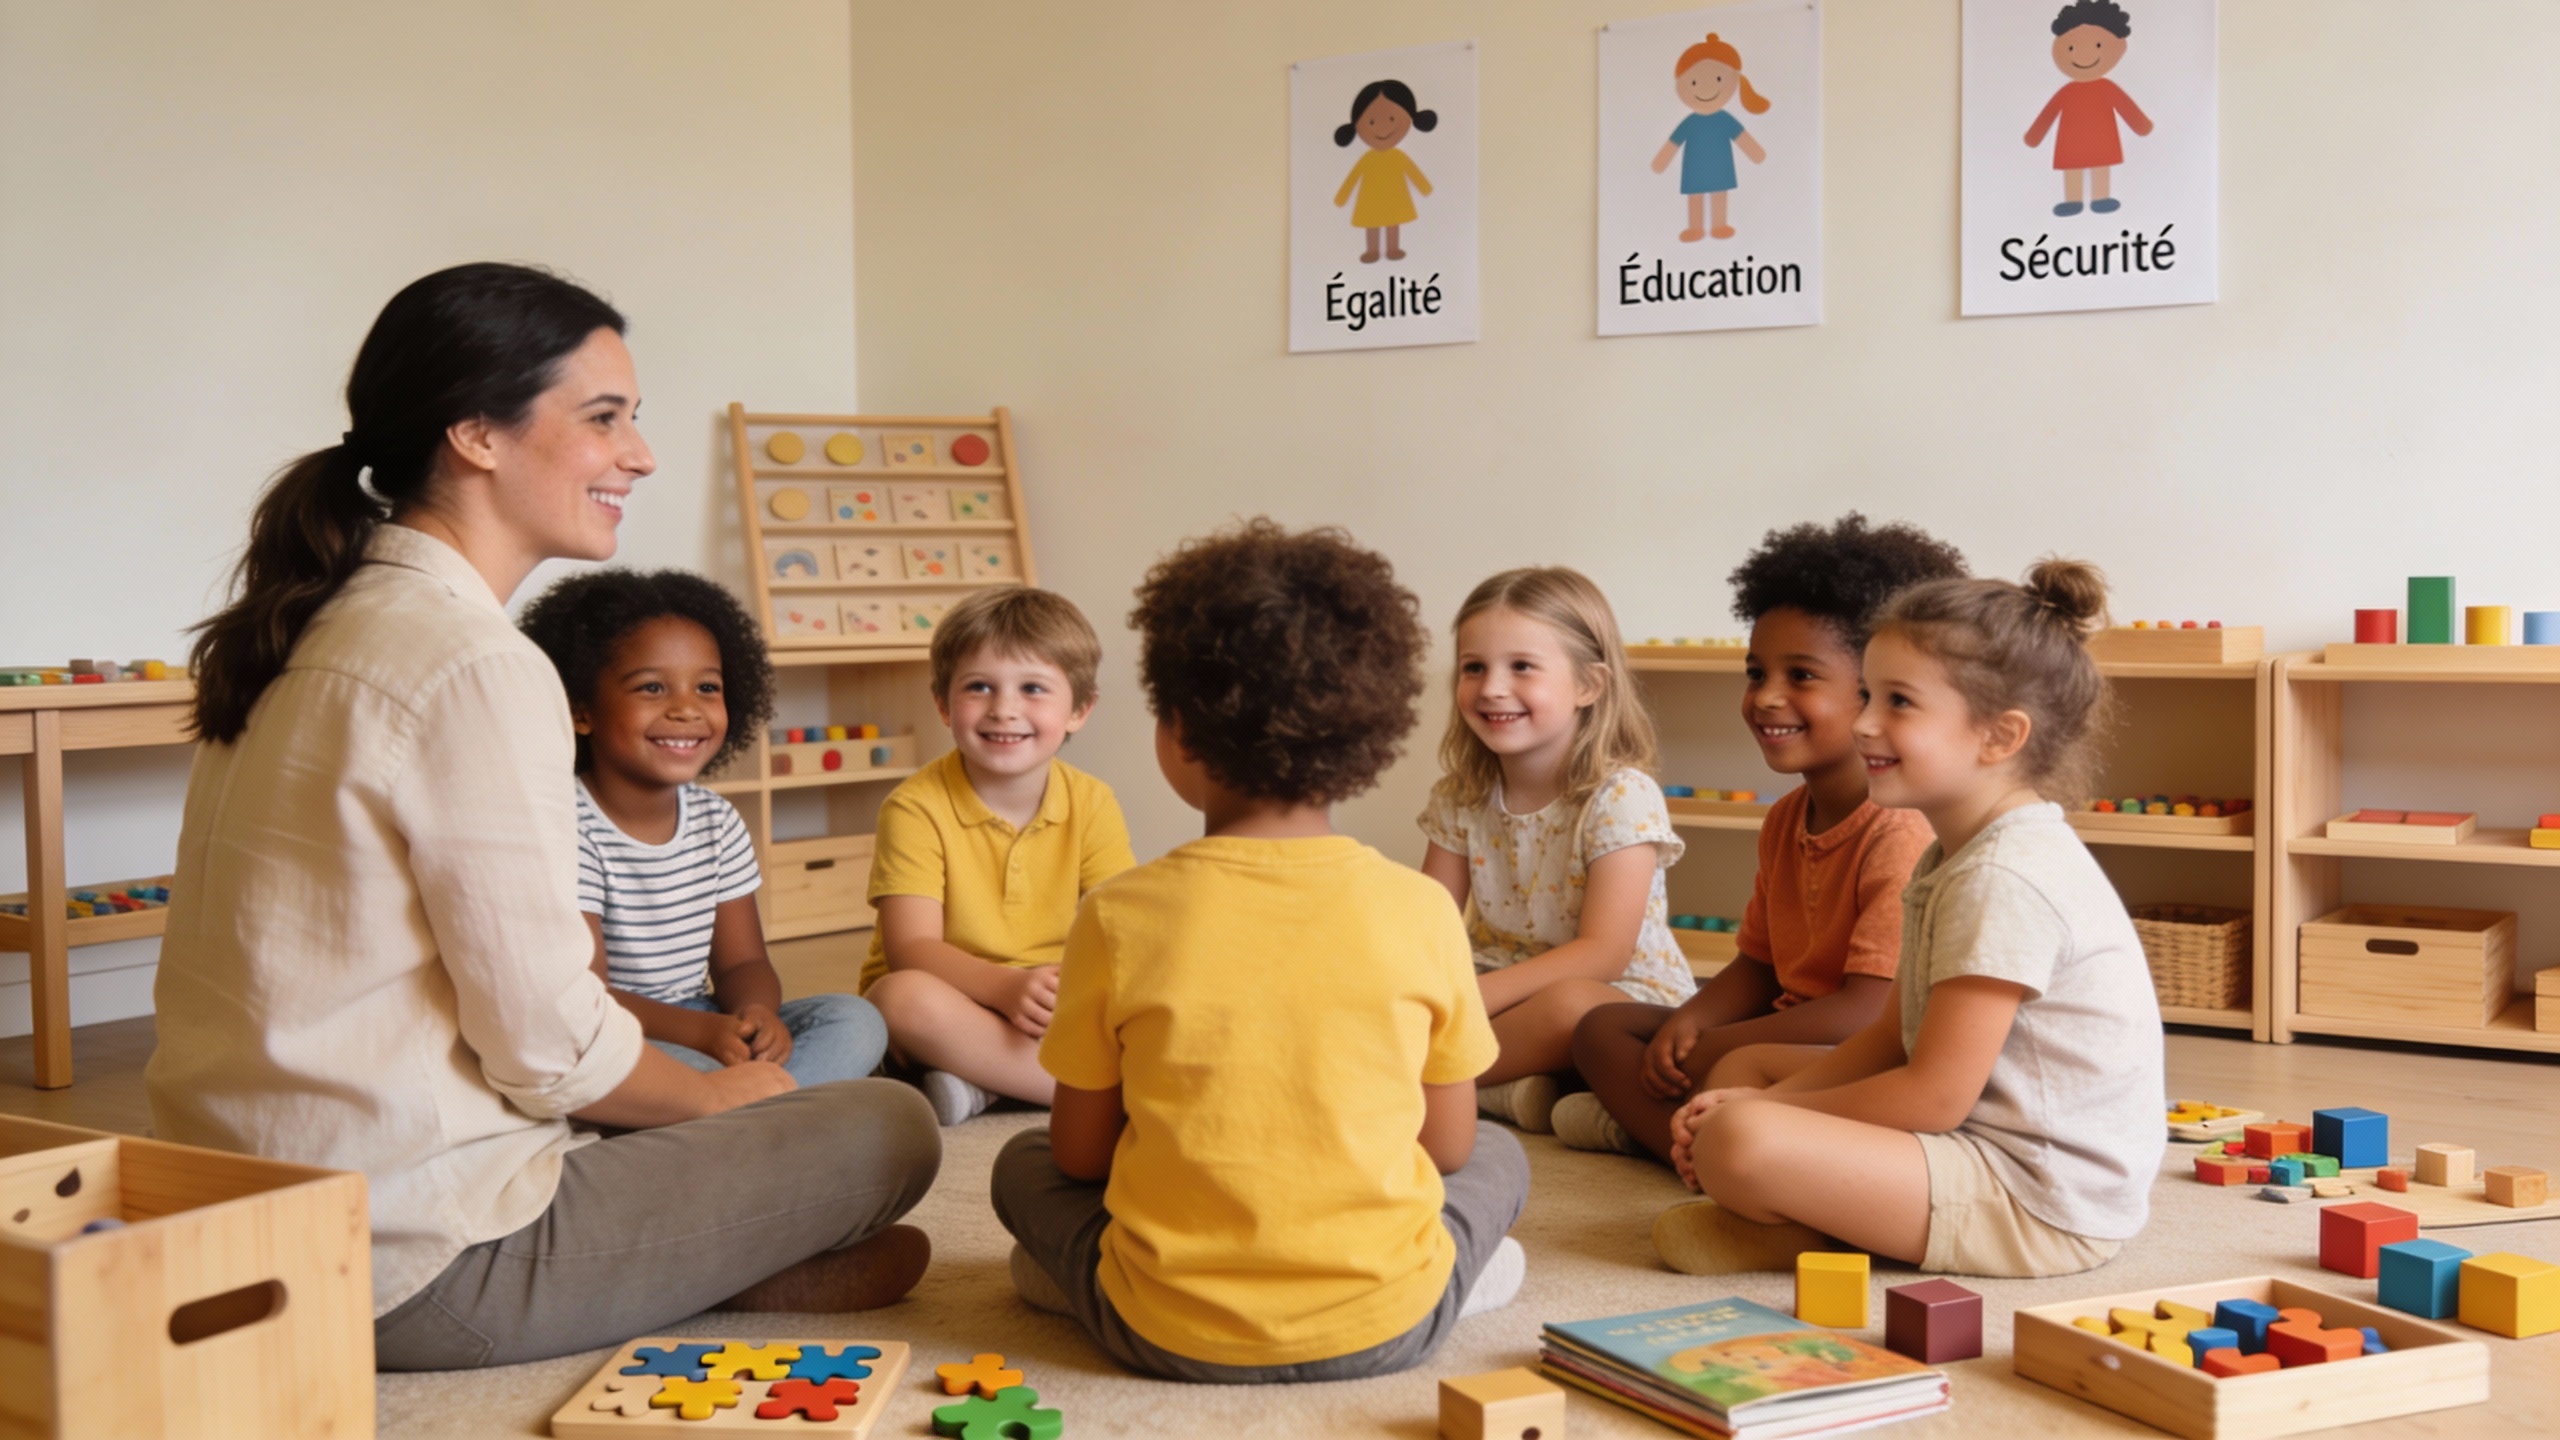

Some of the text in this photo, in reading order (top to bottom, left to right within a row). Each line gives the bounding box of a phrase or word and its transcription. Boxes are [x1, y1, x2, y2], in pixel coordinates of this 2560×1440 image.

[1619, 252, 1801, 305] Éducation
[1999, 223, 2176, 281] Sécurité
[1326, 272, 1442, 331] Égalité
